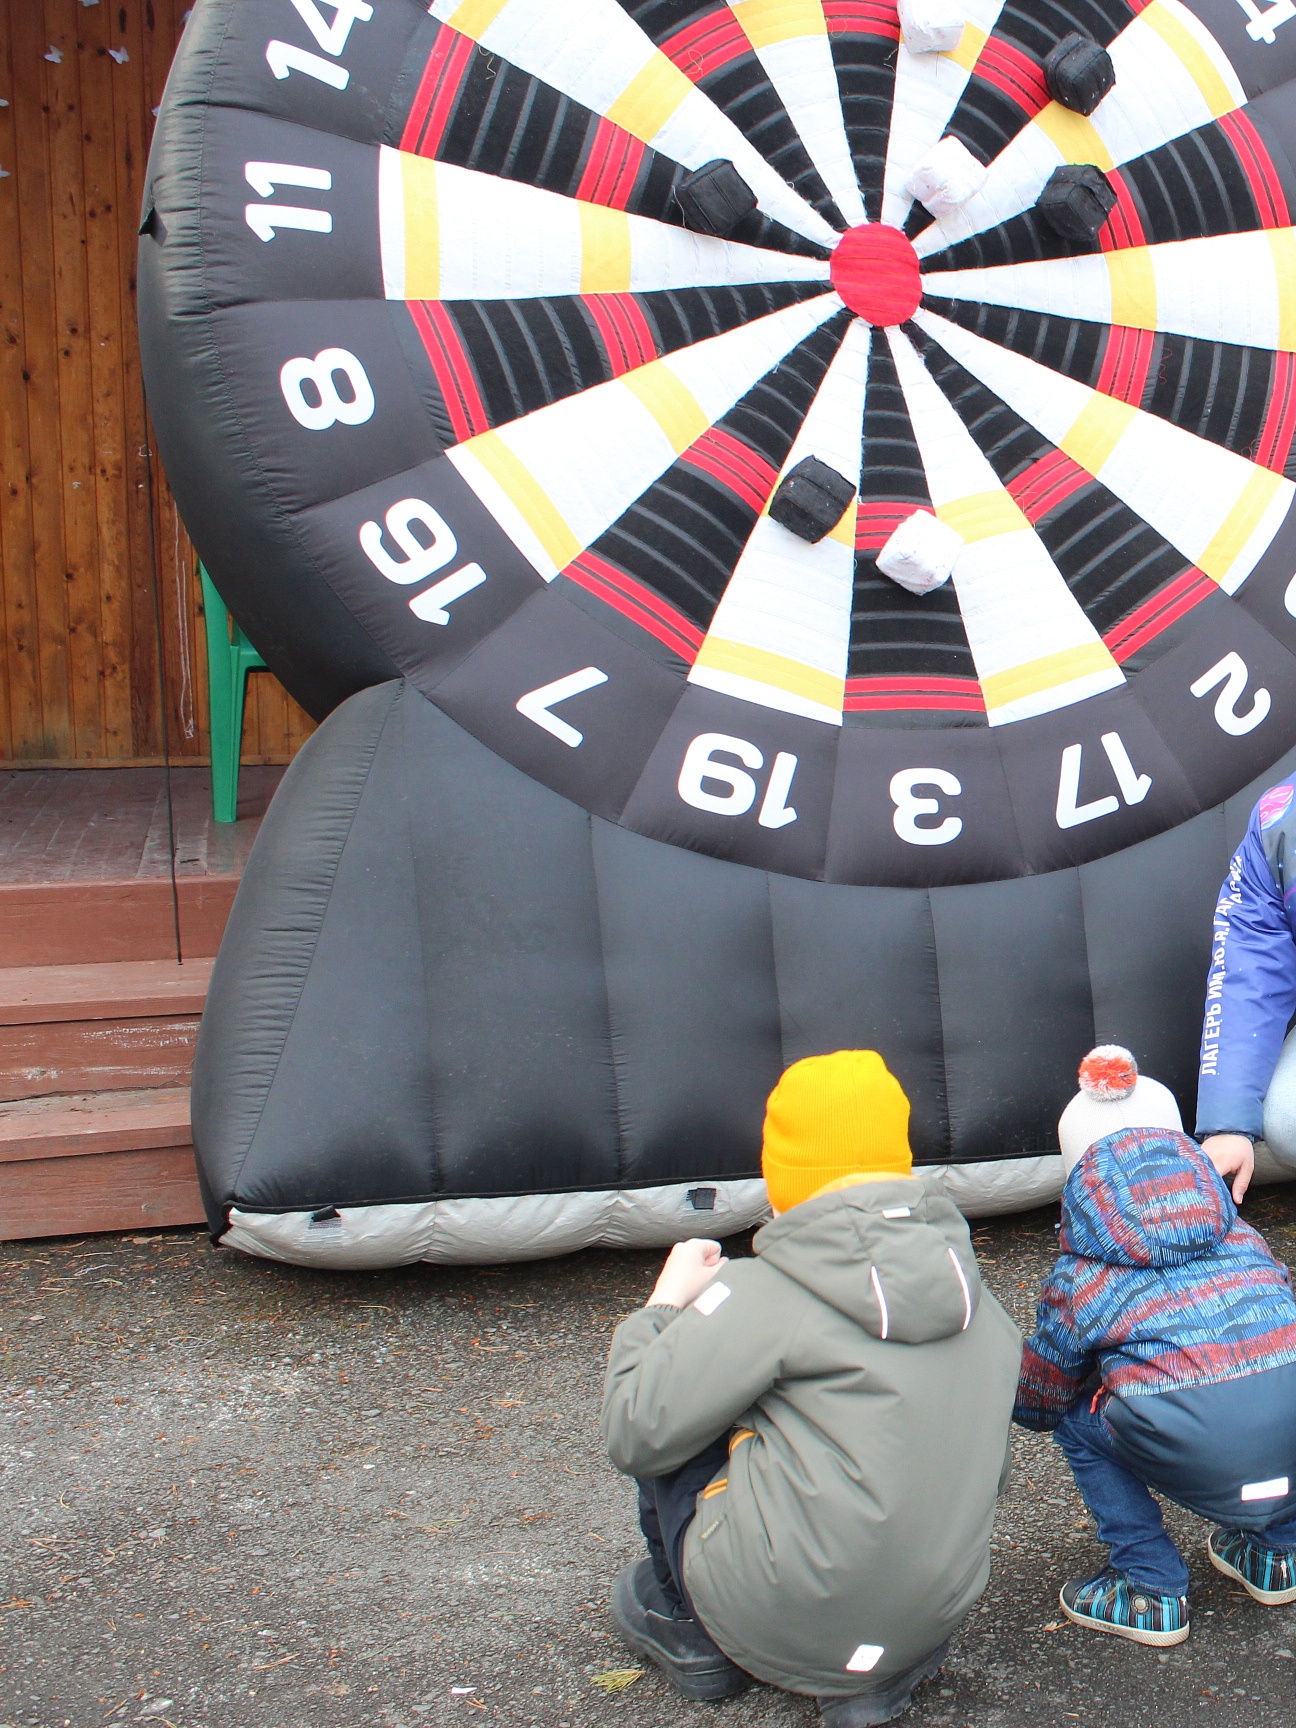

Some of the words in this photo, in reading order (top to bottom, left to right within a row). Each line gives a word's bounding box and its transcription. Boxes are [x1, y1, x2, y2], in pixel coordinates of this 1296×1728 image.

[265, 0, 374, 91] 14
[244, 161, 333, 243] 11
[280, 347, 375, 431] 8
[359, 497, 487, 626] 16
[515, 666, 609, 748] 7
[1189, 651, 1272, 736] 2
[677, 732, 798, 829] 19
[889, 767, 963, 846] 3
[1055, 731, 1153, 829] 17
[1201, 1002, 1222, 1076] ЛАГЕРЬ
